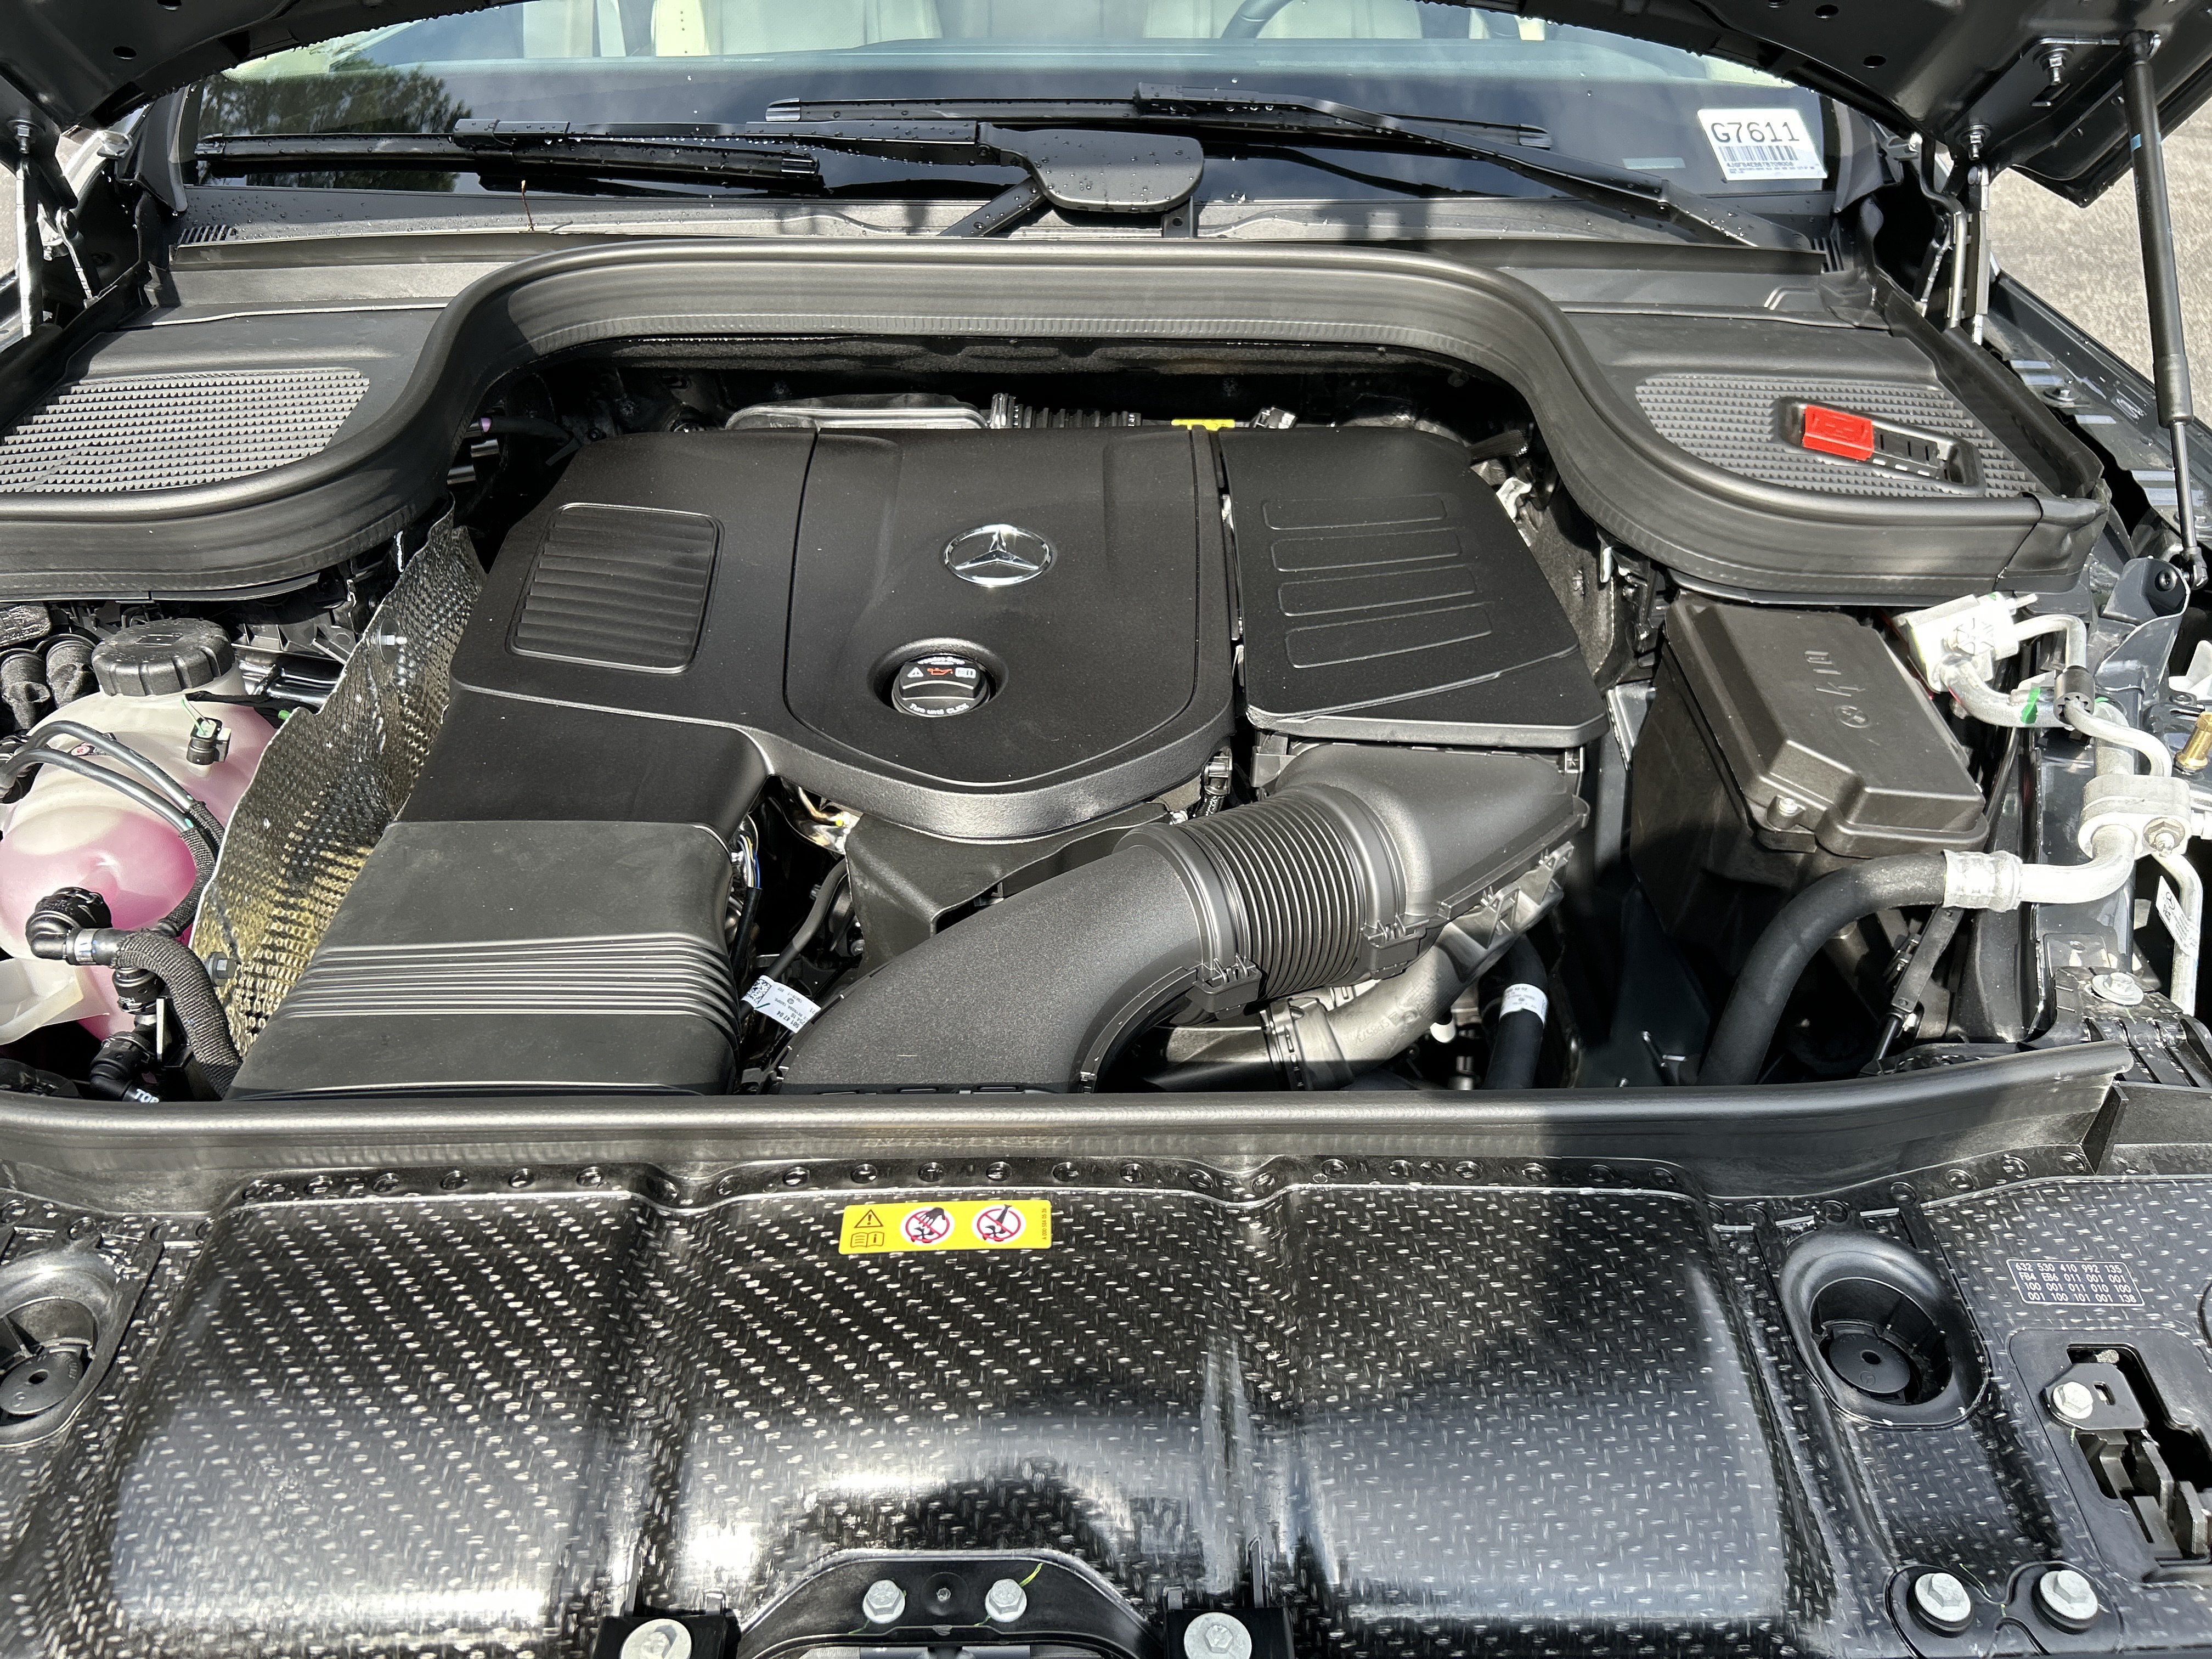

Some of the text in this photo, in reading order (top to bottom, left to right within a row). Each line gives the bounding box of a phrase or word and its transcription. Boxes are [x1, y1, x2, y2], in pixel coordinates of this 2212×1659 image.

[1711, 122, 1800, 143] G7611
[909, 703, 926, 713] Turn
[2015, 1262, 2122, 1273] 632 530 410 992 135
[2018, 1272, 2126, 1283] FB4 EB6 011 001 001
[2024, 1282, 2131, 1293] 100 001 011 010 100
[2028, 1292, 2137, 1303] 001 100 101 001 138
